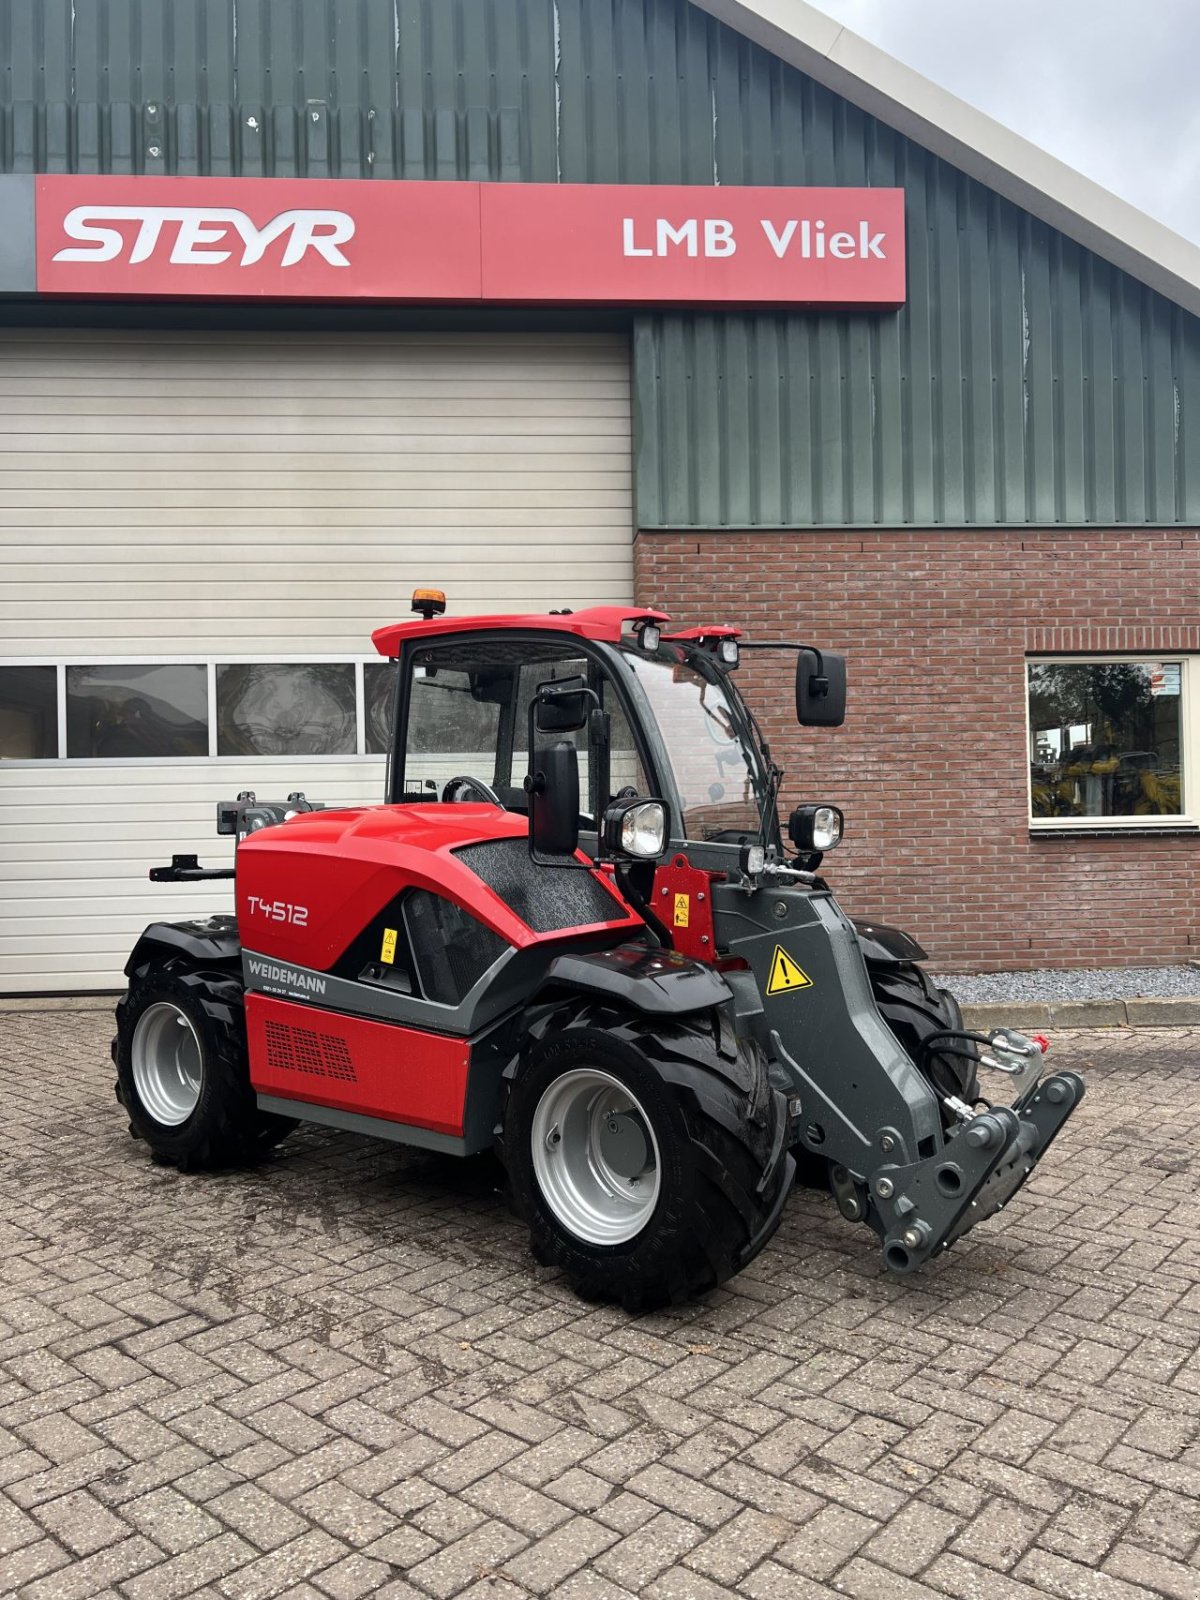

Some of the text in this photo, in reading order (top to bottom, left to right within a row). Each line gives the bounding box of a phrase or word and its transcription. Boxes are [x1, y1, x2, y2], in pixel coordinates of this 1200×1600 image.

[52, 205, 356, 267] STEYR
[623, 218, 886, 259] LMB Vliek
[247, 896, 308, 926] T4512
[248, 960, 326, 994] WEIDEMANN
